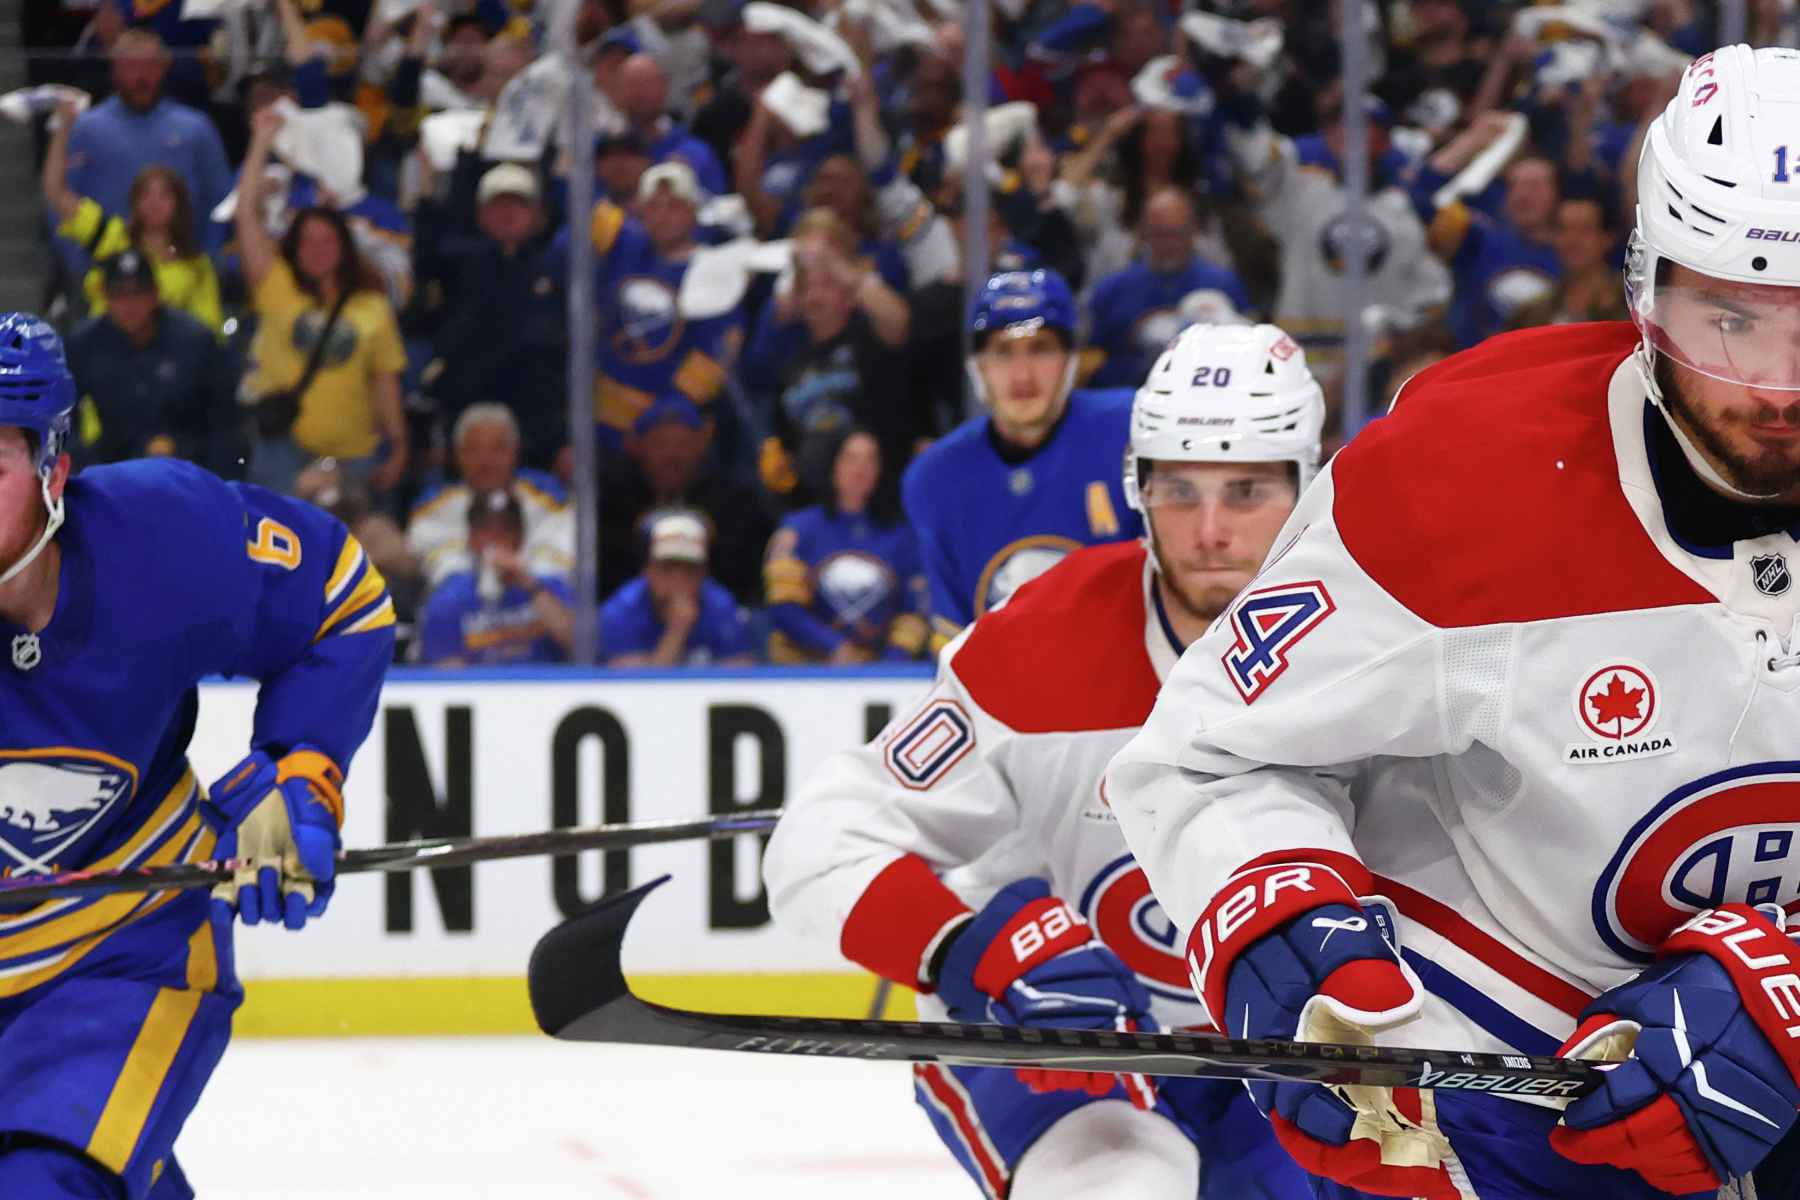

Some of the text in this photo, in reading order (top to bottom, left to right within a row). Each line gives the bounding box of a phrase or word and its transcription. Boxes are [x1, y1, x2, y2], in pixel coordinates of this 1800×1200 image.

[1191, 366, 1231, 387] 20
[1177, 416, 1235, 427] BAUER
[1087, 482, 1120, 537] A
[1214, 524, 1338, 706] 4
[876, 699, 977, 791] 0
[1569, 738, 1673, 759] AIR CANADA
[383, 703, 891, 932] NOB
[736, 1036, 898, 1057] FLYLITE
[1434, 1072, 1585, 1096] BAUER
